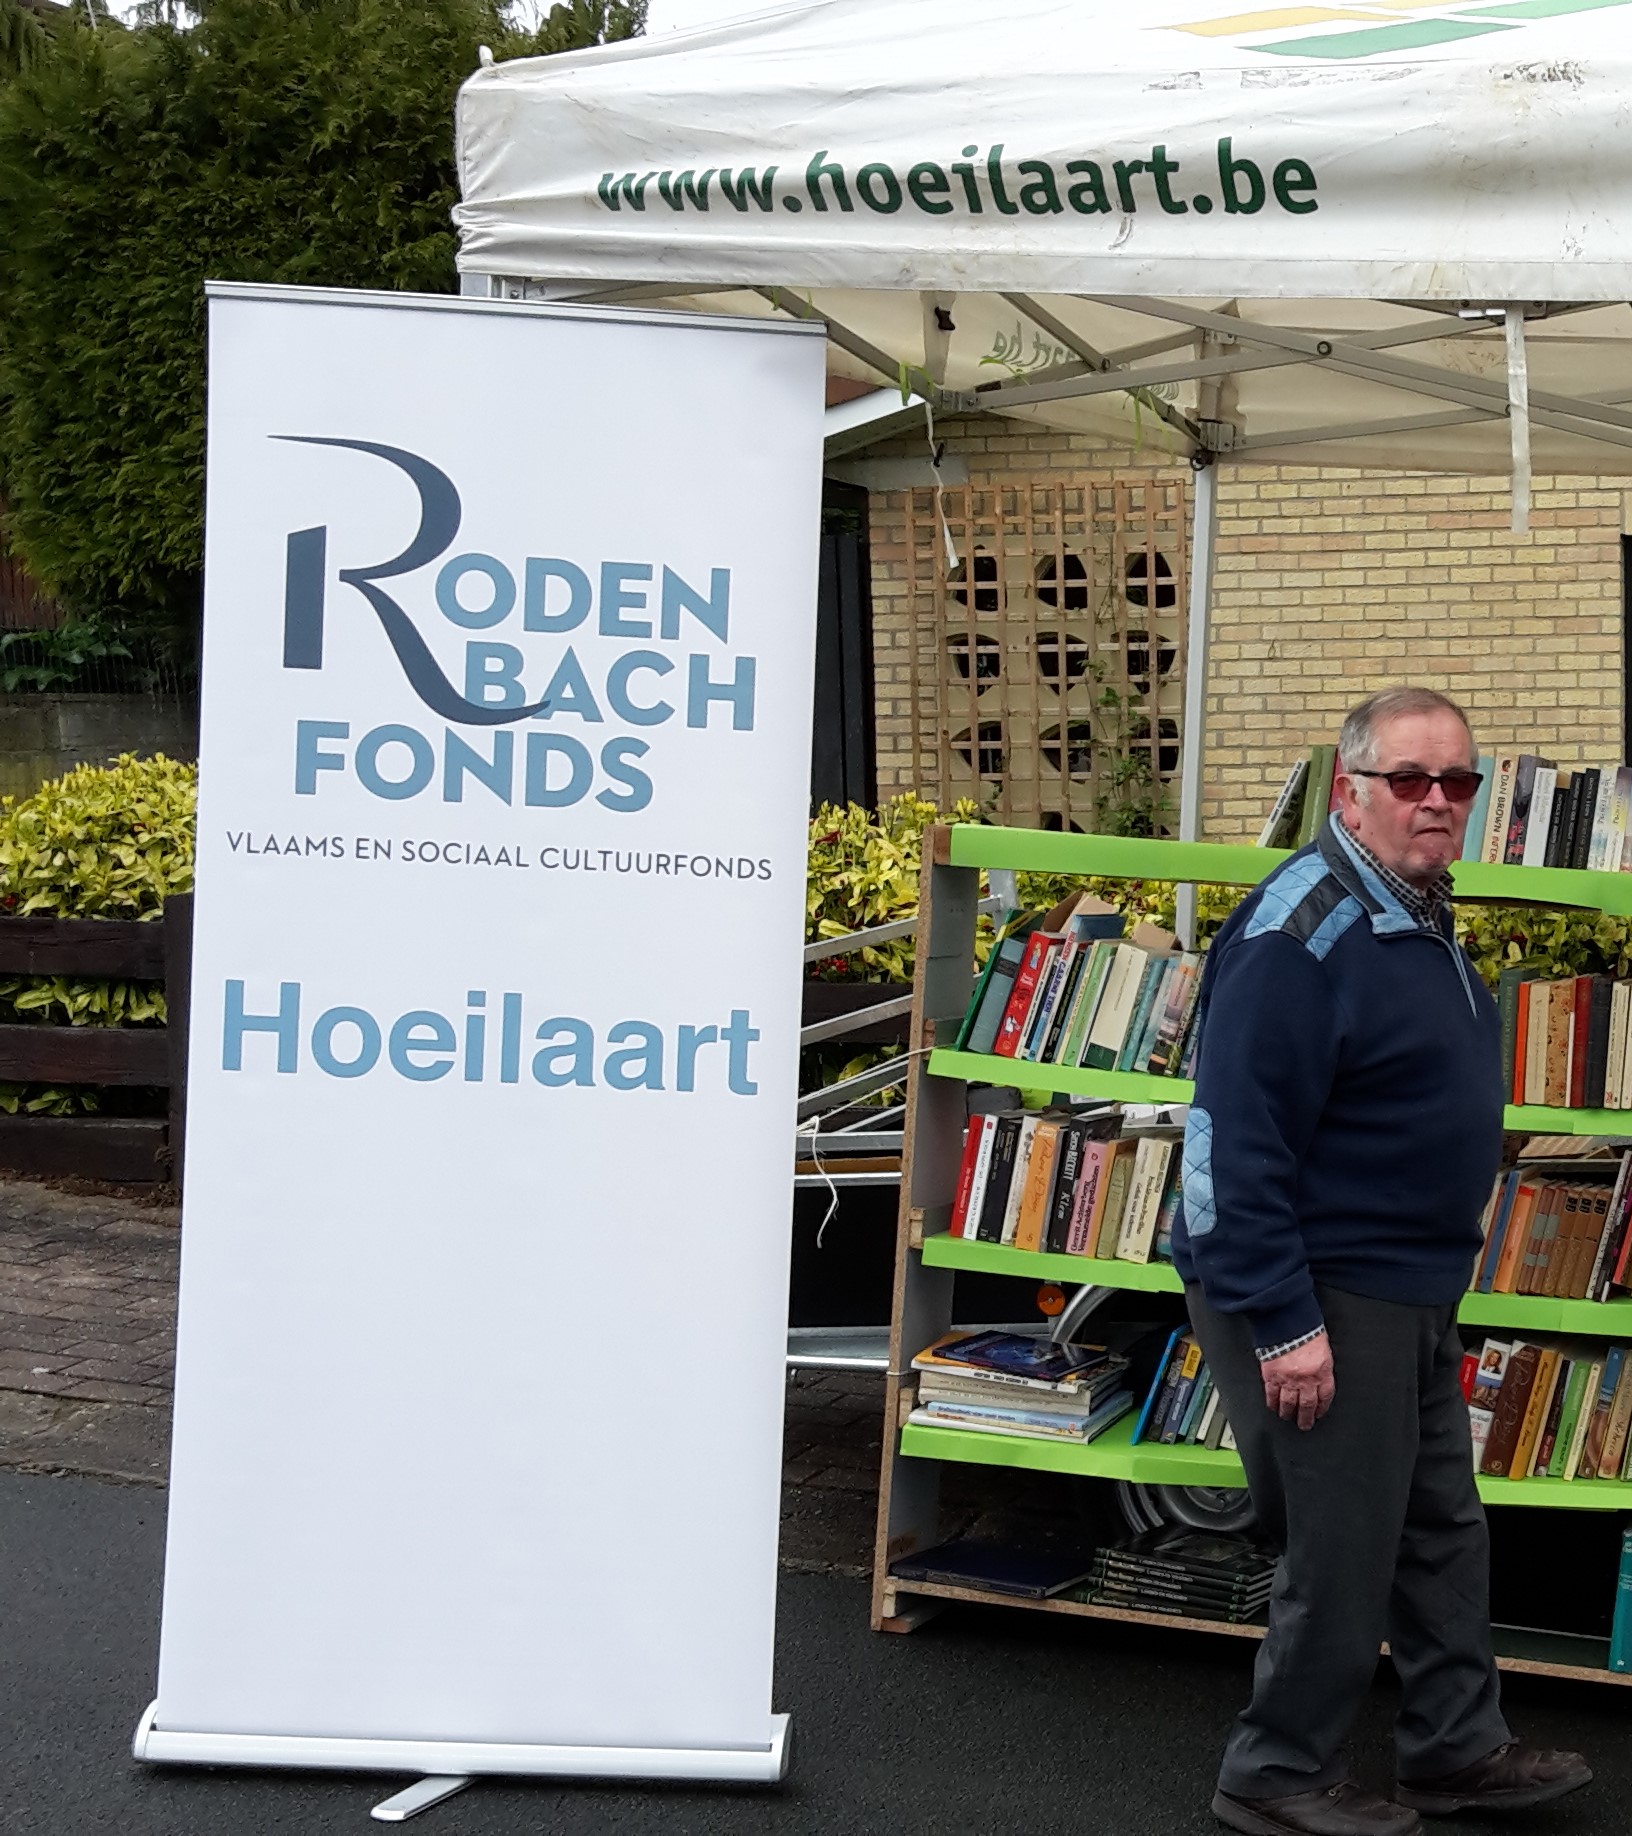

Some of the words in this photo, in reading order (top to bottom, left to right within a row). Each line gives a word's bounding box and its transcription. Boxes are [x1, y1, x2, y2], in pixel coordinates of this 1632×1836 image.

[596, 136, 1320, 216] www.hoeilaart.be
[463, 640, 757, 732] BACH
[294, 719, 654, 813] FONDS
[1500, 773, 1510, 797] DAN
[1493, 796, 1506, 833] BROWN
[226, 830, 345, 859] VLAAMS
[355, 837, 393, 862] EN
[400, 839, 530, 869] SOCIAAL
[538, 847, 774, 881] CULTUURFONDS
[221, 978, 761, 1097] Hoeilaart
